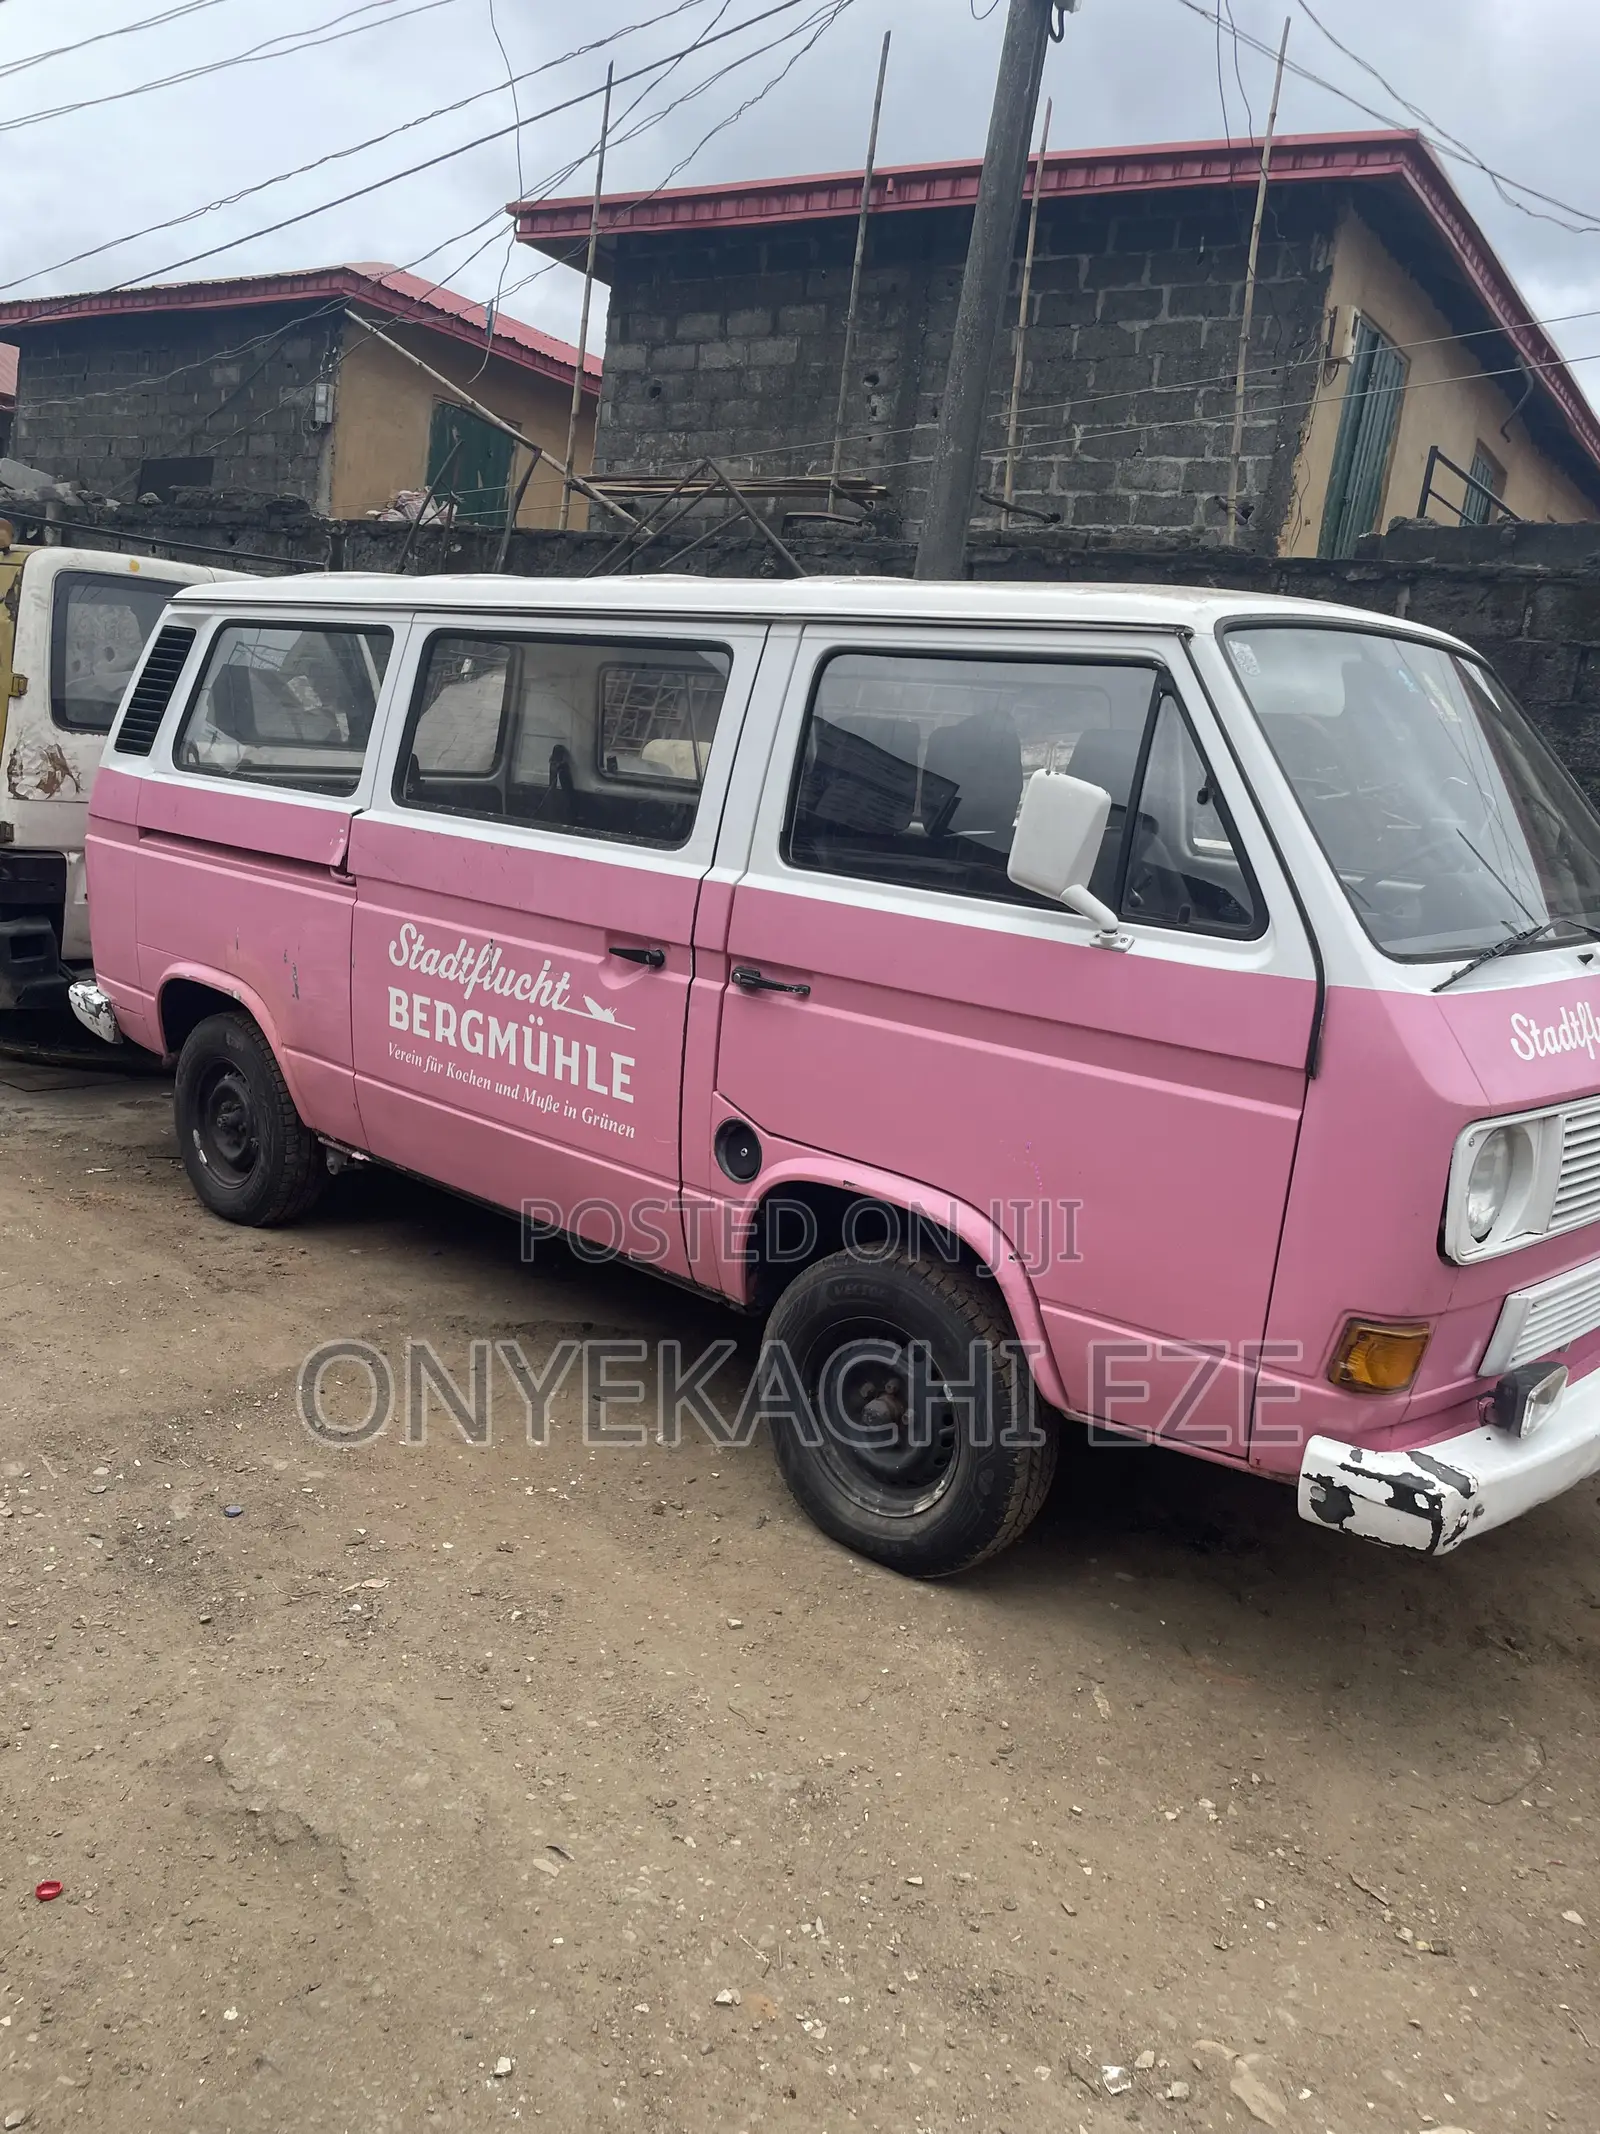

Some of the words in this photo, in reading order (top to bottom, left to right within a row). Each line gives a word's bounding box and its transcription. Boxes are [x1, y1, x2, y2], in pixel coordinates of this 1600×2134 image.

[388, 922, 570, 1011] Stadtflucht
[387, 985, 636, 1104] BERGMÜHLE
[1510, 1001, 1600, 1061] Stadtfl
[387, 1041, 423, 1068] Verein
[422, 1054, 444, 1075] für
[446, 1061, 491, 1091] Kochen
[494, 1081, 520, 1101] und
[522, 1086, 560, 1115] Muße
[563, 1100, 577, 1119] in
[581, 1106, 636, 1139] Grünen
